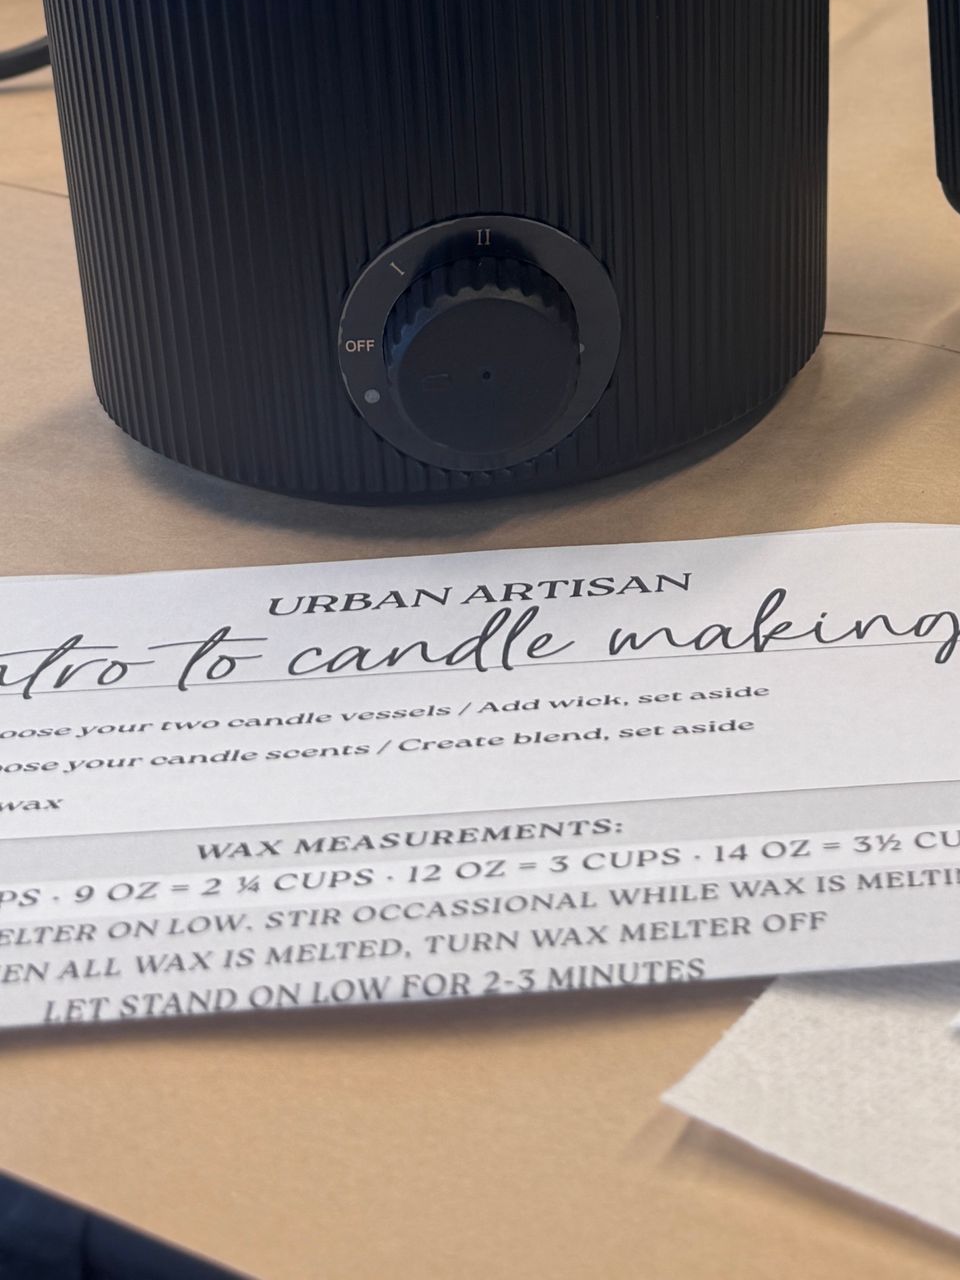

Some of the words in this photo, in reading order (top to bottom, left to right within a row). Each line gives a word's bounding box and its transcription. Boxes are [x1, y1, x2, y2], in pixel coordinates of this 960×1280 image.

[345, 339, 375, 353] OFF
[268, 586, 453, 616] URBAN
[460, 571, 692, 605] ARTISAN
[148, 625, 268, 692] to
[288, 605, 575, 677] candle
[75, 722, 153, 738] your
[160, 719, 220, 732] two
[227, 711, 332, 728] candle
[341, 704, 452, 721] vessels
[477, 699, 540, 714] Add
[549, 694, 629, 709] wick,
[638, 691, 683, 704] set
[690, 686, 770, 701] aside
[0, 761, 59, 773] ose
[62, 757, 143, 774] your
[150, 748, 257, 767] candle
[265, 743, 370, 761] scents
[398, 736, 505, 753] Create
[513, 728, 609, 745] blend,
[619, 725, 664, 738] set
[672, 719, 754, 736] aside
[197, 839, 283, 860] WAX
[294, 818, 624, 856] MEASUREMENTS:
[74, 885, 94, 903] 9
[107, 881, 160, 902] OZ
[201, 877, 222, 896] 2
[274, 868, 374, 892] CUPS
[408, 864, 441, 883] 12
[455, 859, 506, 879] OZ
[550, 855, 569, 873] 3
[582, 847, 680, 871] CUPS
[715, 844, 748, 862] 14
[761, 839, 811, 859] OZ
[107, 919, 159, 939] ON
[168, 913, 253, 936] LOW.
[265, 907, 341, 930] STIR
[353, 890, 598, 924] OCCASSIONAL
[610, 882, 720, 907] WHILE
[730, 877, 805, 899] WAX
[817, 874, 846, 893] IS
[0, 962, 49, 984] EN
[57, 956, 122, 980] ALL
[135, 950, 214, 975] WAX
[223, 947, 255, 968] IS
[265, 938, 412, 966] MELTED,
[425, 930, 520, 955] TURN
[531, 925, 609, 948] WAX
[620, 916, 752, 944] MELTER
[762, 910, 828, 932] OFF
[43, 996, 110, 1023] LET
[119, 987, 238, 1018] STAND
[249, 982, 301, 1009] ON
[312, 975, 391, 1005] LOW
[402, 971, 471, 1000] FOR
[484, 967, 537, 995] 2-3
[548, 957, 706, 991] MINUTES
